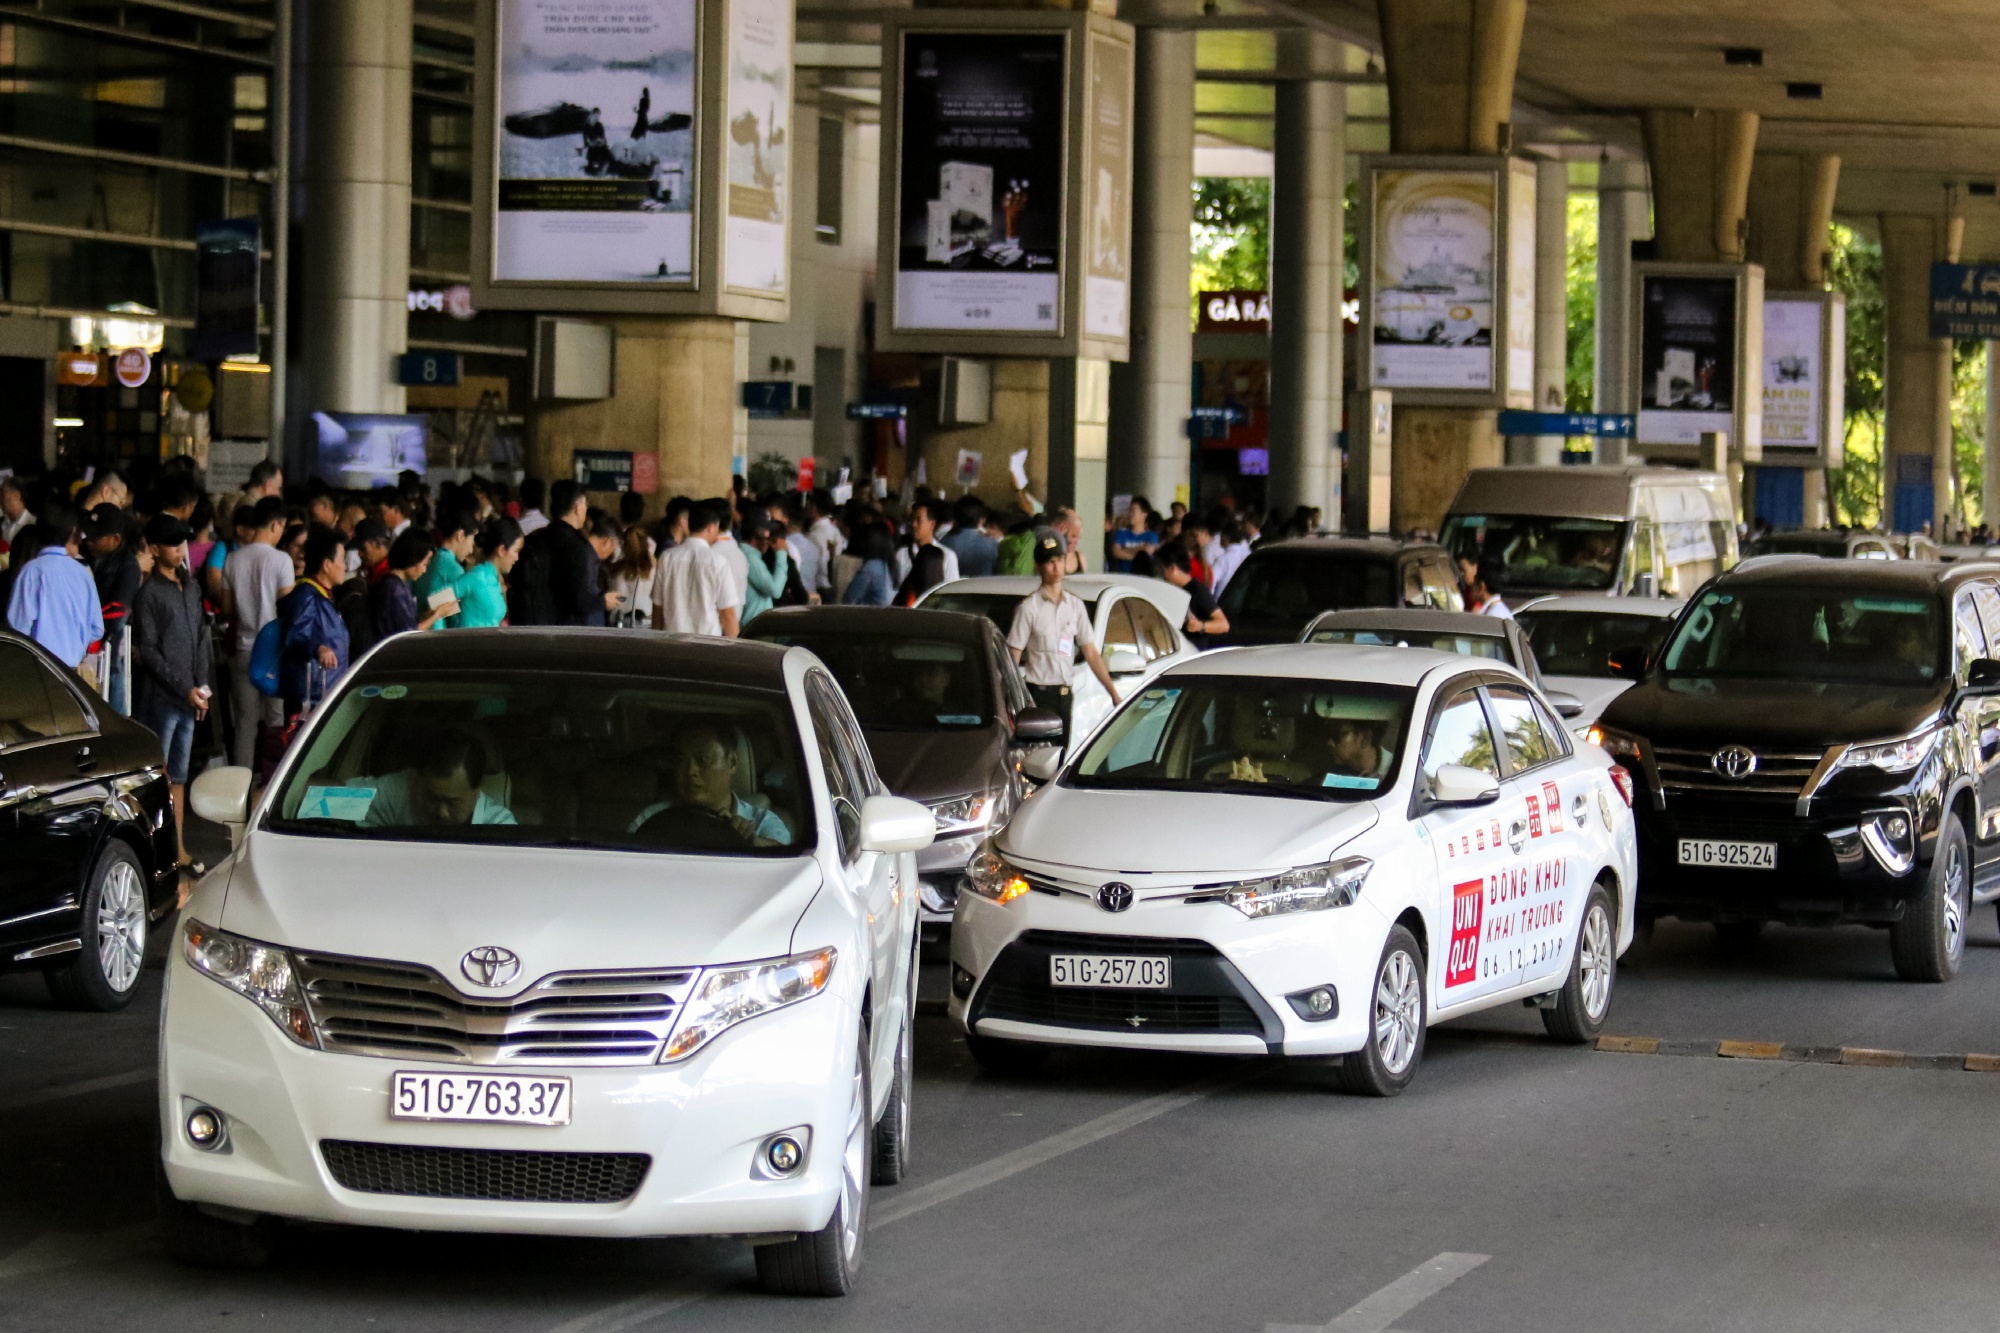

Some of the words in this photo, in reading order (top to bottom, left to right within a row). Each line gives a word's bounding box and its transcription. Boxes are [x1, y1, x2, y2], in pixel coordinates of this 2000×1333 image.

[1207, 294, 1241, 322] GÀ
[424, 358, 437, 382] 8
[763, 386, 776, 404] 7
[1682, 842, 1773, 866] 51G-925.24
[1455, 893, 1478, 931] UNI
[1487, 912, 1516, 943] KHAI
[1055, 957, 1166, 985] 51G-257.03
[1450, 935, 1476, 980] QLO
[399, 1077, 566, 1118] 51G-763.37
